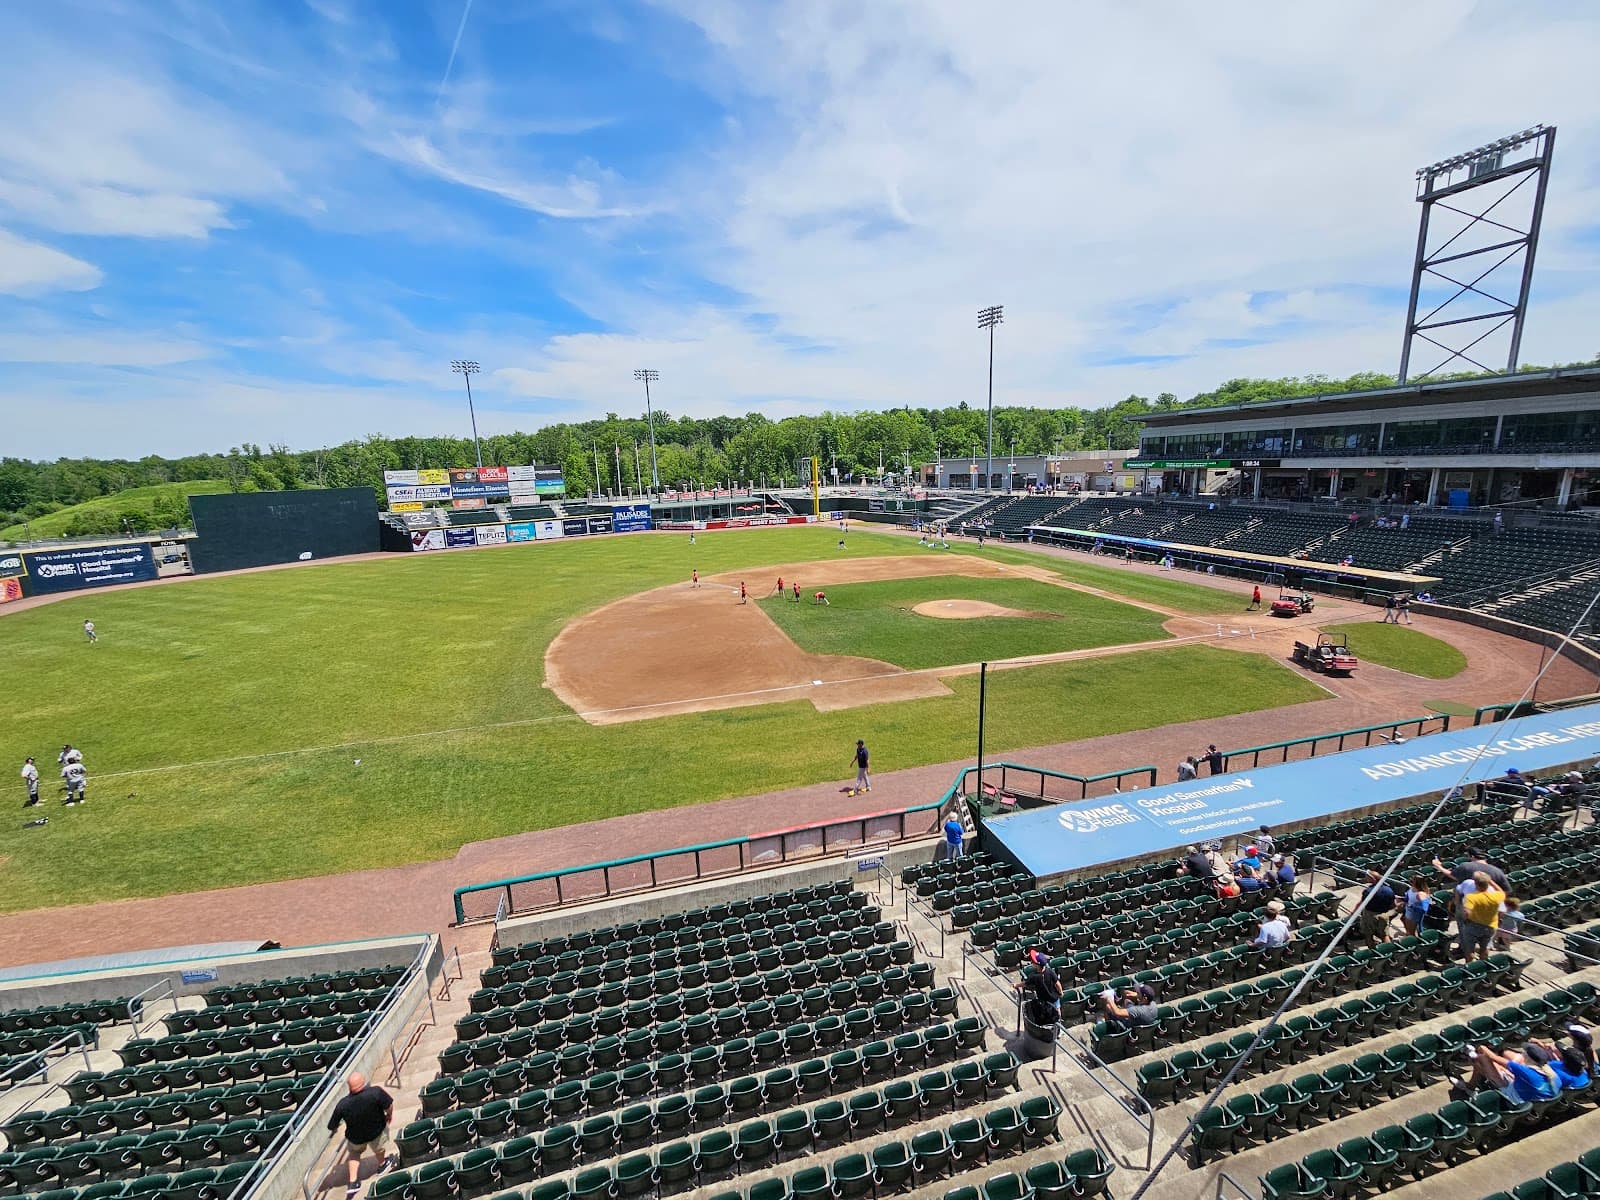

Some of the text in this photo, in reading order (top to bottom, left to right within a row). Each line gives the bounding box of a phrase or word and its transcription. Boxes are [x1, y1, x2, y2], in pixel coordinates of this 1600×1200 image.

[83, 565, 111, 573] Hospital
[1360, 744, 1507, 781] ADVANCING
[1137, 782, 1243, 809] Good Samaritan
[1081, 803, 1129, 819] WMC
[1148, 799, 1209, 818] Hospital
[1092, 813, 1142, 829] Health
